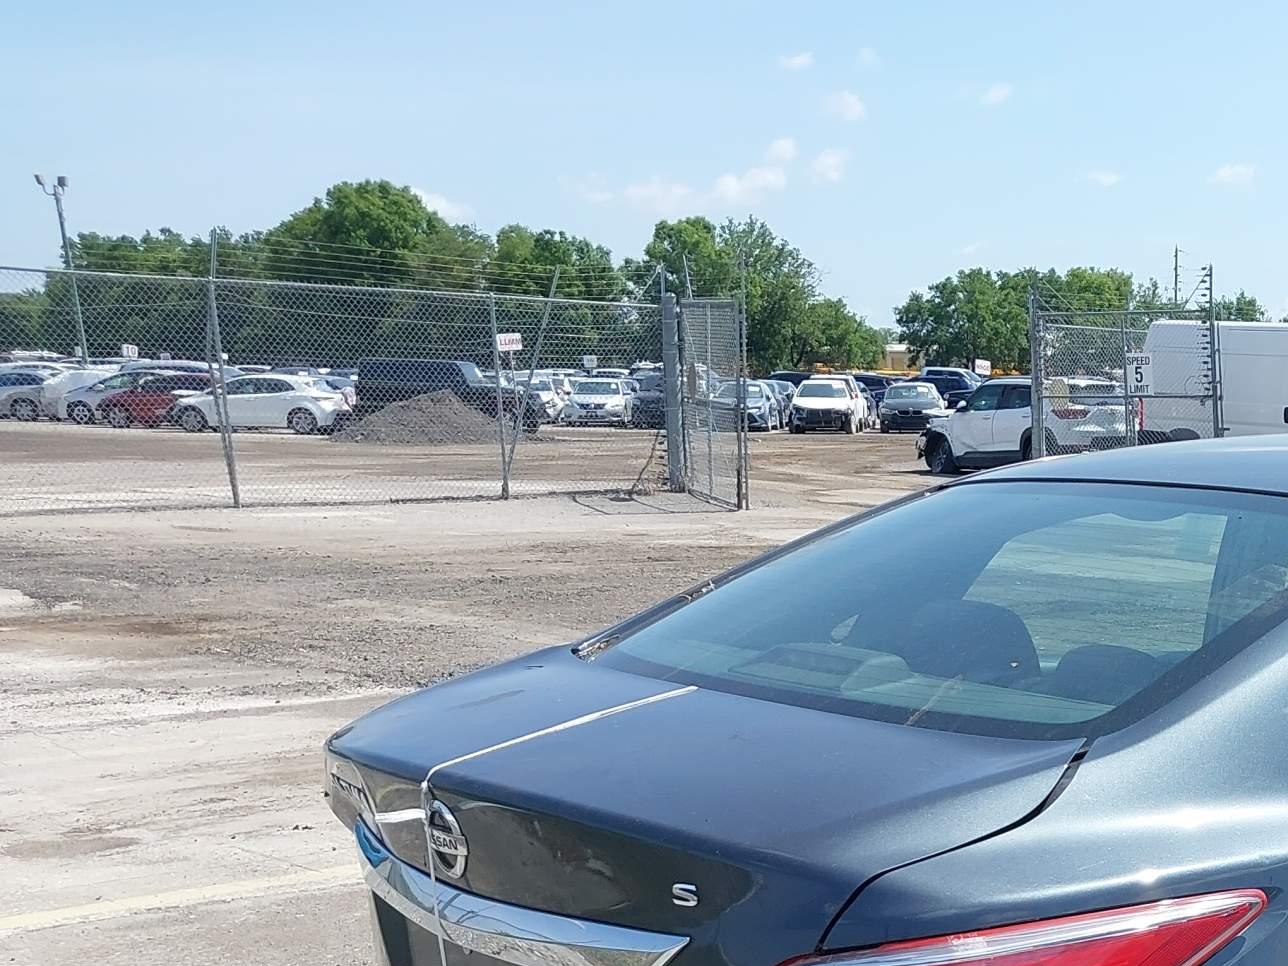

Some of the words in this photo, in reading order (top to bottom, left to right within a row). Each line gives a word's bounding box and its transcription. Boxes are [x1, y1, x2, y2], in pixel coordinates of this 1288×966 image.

[126, 346, 137, 356] 10
[1126, 356, 1150, 365] SPEED
[1134, 366, 1144, 383] 5
[1129, 384, 1150, 393] LIMIT
[672, 883, 698, 906] S
